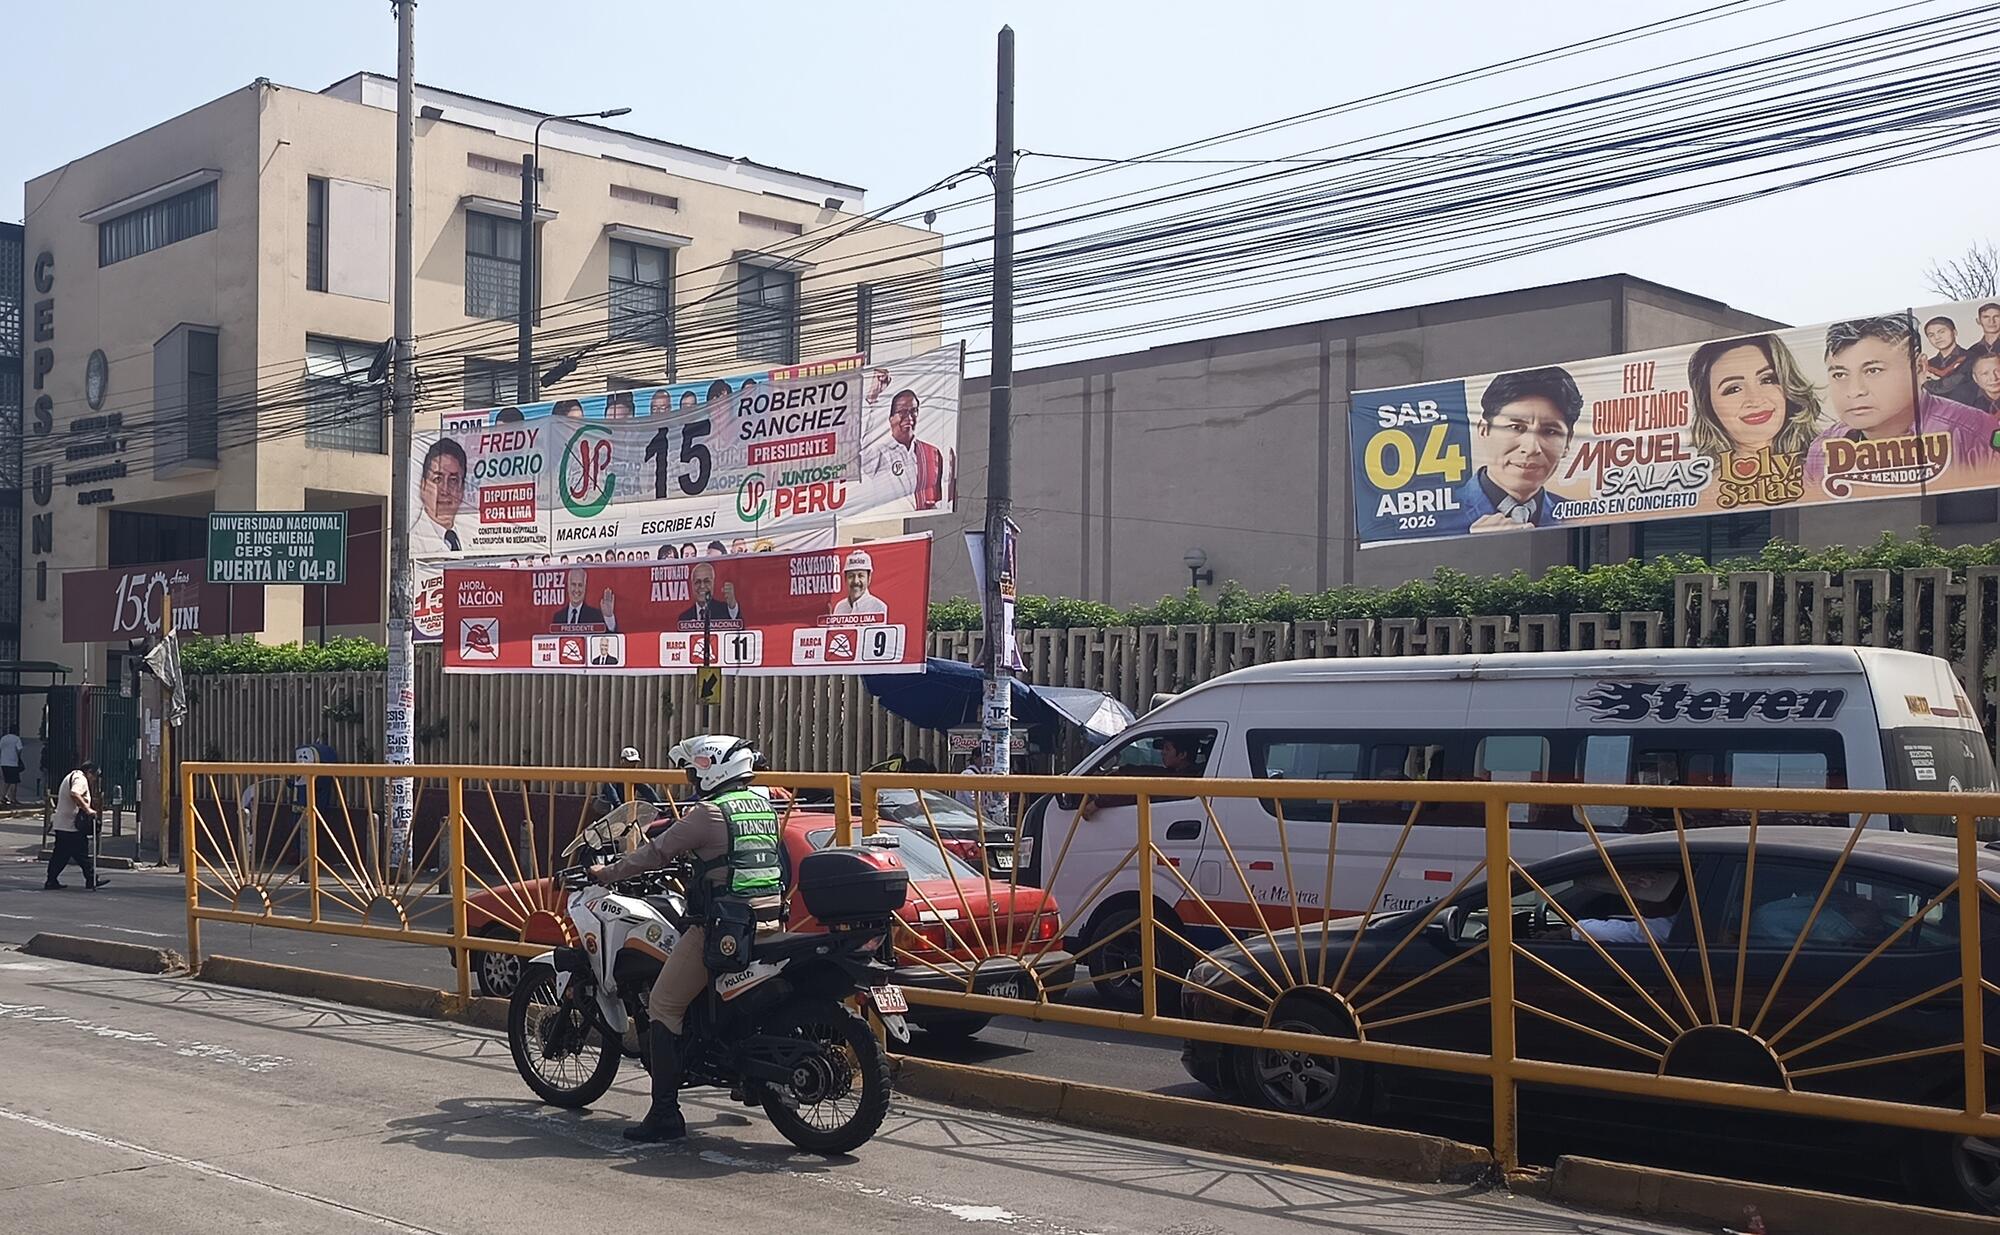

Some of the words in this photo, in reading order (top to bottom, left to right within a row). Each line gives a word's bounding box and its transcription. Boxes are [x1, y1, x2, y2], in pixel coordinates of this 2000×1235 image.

[33, 251, 55, 434] CEPS
[1623, 361, 1655, 394] FELIZ
[738, 381, 848, 417] ROBERTO
[739, 405, 847, 441] SANCHEZ
[1377, 400, 1448, 428] SAB.
[1592, 389, 1689, 436] CUMPLEAÑOS
[479, 428, 539, 454] FREDY
[754, 438, 828, 462] PRESIDENTE
[473, 454, 542, 479] OSORIO
[645, 419, 711, 498] 15
[1364, 423, 1466, 490] 04
[1564, 432, 1691, 490] MIGUEL
[1825, 434, 1949, 475] Danny
[777, 467, 832, 487] JUNTOS
[1601, 459, 1710, 497] SALAS
[1871, 468, 1934, 484] MENDOZA
[484, 487, 534, 503] DIPUTADO
[774, 479, 847, 518] PERÚ
[1376, 488, 1460, 517] ABRIL
[1553, 504, 1564, 518] 4
[1565, 499, 1606, 518] HORAS
[1608, 497, 1626, 514] EN
[1627, 492, 1697, 512] CONCIERTO
[212, 517, 283, 530] UNIVERSIDAD
[286, 517, 340, 530] NACIONAL
[485, 507, 505, 520] POR
[507, 505, 532, 519] LIMA
[641, 517, 693, 535] ESCRIBE
[694, 511, 716, 530] ASÍ
[1399, 515, 1436, 530] 2026
[32, 464, 53, 601] UNI
[236, 531, 250, 544] DE
[254, 531, 315, 544] INGENIERIA
[556, 526, 597, 542] MARCA
[599, 521, 619, 538] ASÍ
[235, 546, 272, 557] CEPS
[288, 546, 314, 557] UNI
[213, 560, 272, 580] PUERTA
[299, 560, 336, 580] 04-B
[651, 565, 689, 581] FORTUNATO
[790, 555, 840, 576] SALVADOR
[458, 580, 486, 591] AHORA
[532, 572, 565, 588] LOPEZ
[651, 581, 690, 601] ALVA
[790, 574, 841, 595] AREVALO
[113, 571, 169, 634] 150
[414, 588, 444, 617] 13
[458, 586, 503, 605] NACIÓN
[533, 589, 565, 606] CHAU
[172, 606, 199, 630] UNI
[680, 621, 706, 629] SENADO
[709, 620, 740, 628] NACIONAL
[826, 616, 859, 624] DIPUTADO
[860, 615, 876, 623] LIMA
[666, 641, 686, 650] MARCA
[732, 636, 748, 660] 11
[800, 637, 822, 647] MARCA
[873, 632, 886, 656] 9
[1578, 682, 1846, 723] Steven
[1270, 886, 1319, 905] Maina
[724, 970, 754, 988] POLICIA
